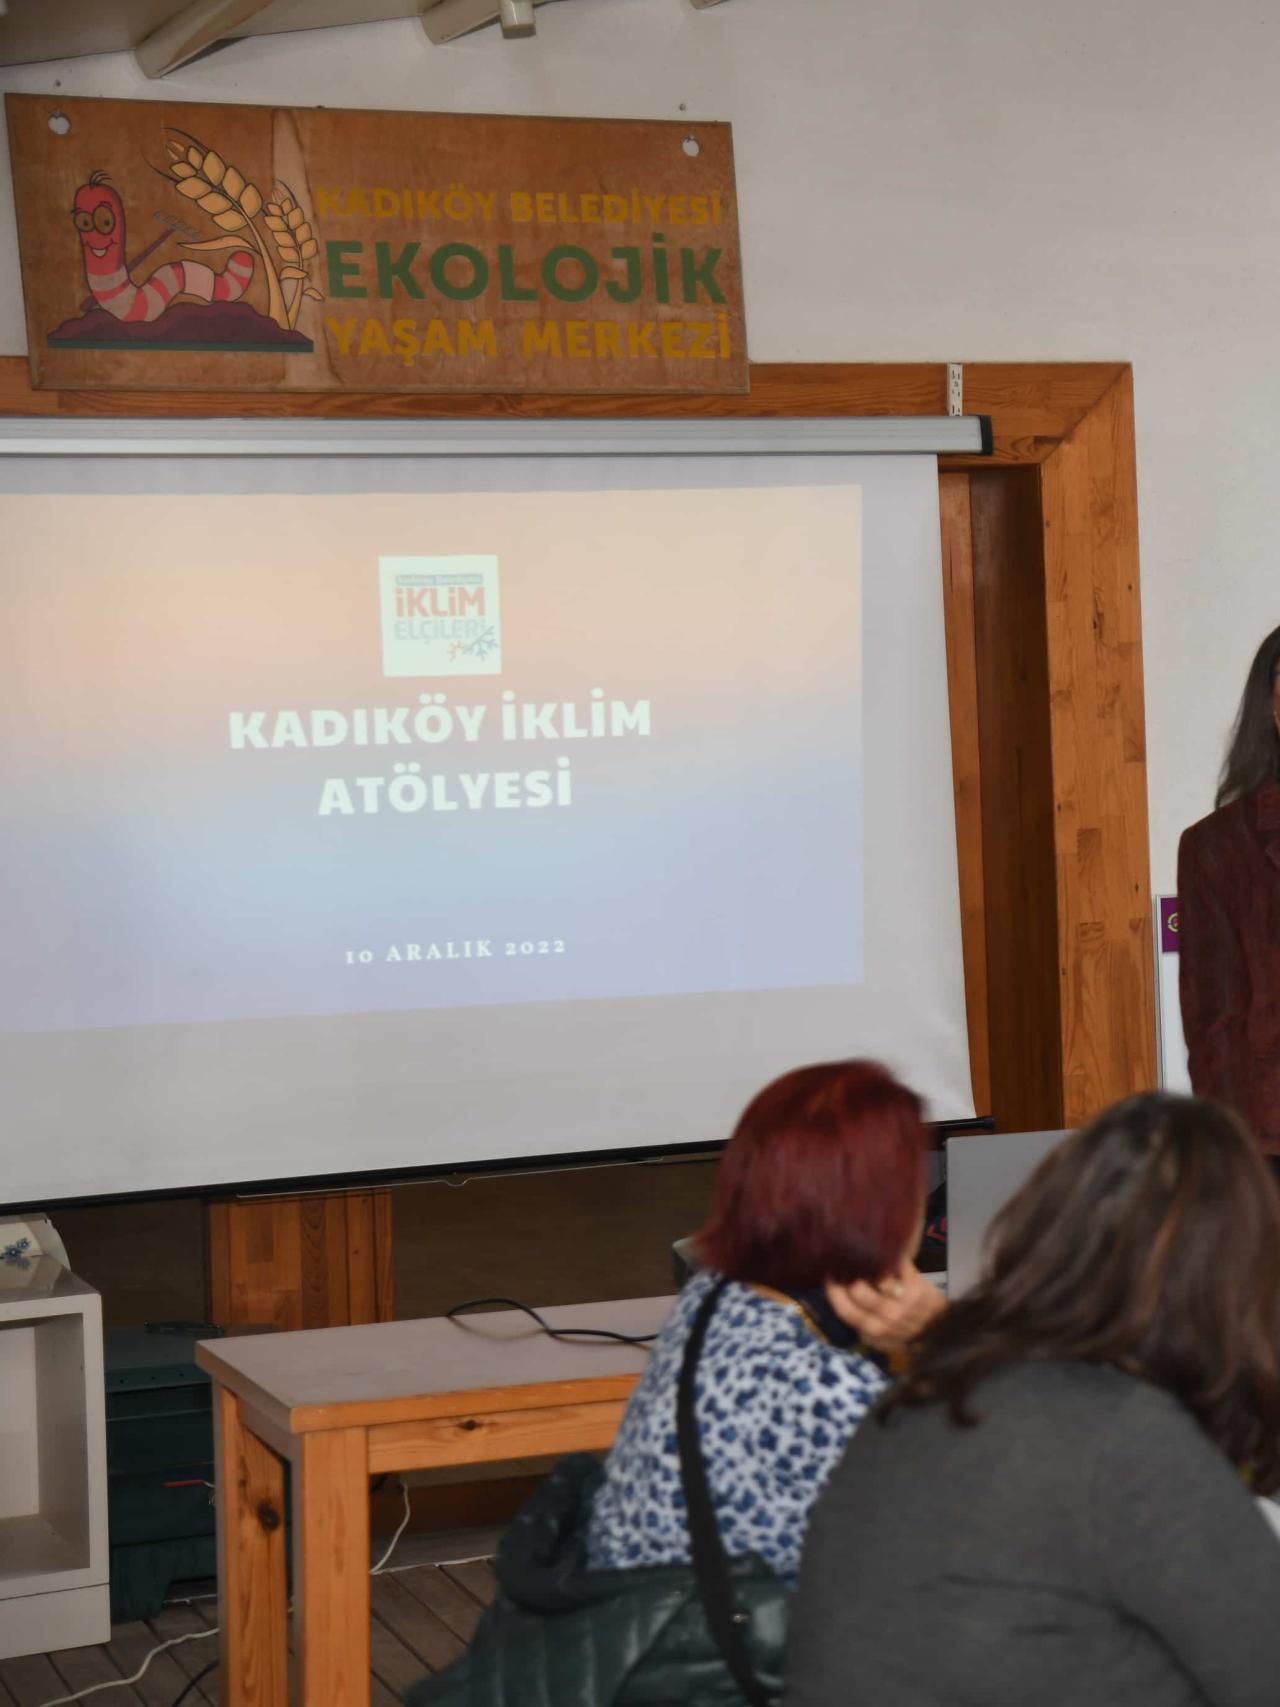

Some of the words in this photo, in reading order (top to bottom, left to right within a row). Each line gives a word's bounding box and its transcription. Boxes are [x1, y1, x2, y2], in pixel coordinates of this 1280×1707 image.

[318, 183, 497, 220] KADIKÖY
[511, 187, 722, 226] BELEDİYESİ
[325, 233, 727, 304] EKOLOJİK
[326, 318, 496, 366] YAŞAM
[523, 312, 730, 359] MERKEZİ
[395, 586, 486, 618] İKLİM
[229, 693, 487, 749] KADIKÖY
[502, 687, 652, 740] İKLİM
[318, 756, 572, 816] ATÖLYESİ
[346, 948, 373, 964] 10
[386, 939, 493, 962] ARALIK
[504, 939, 566, 956] 2022
